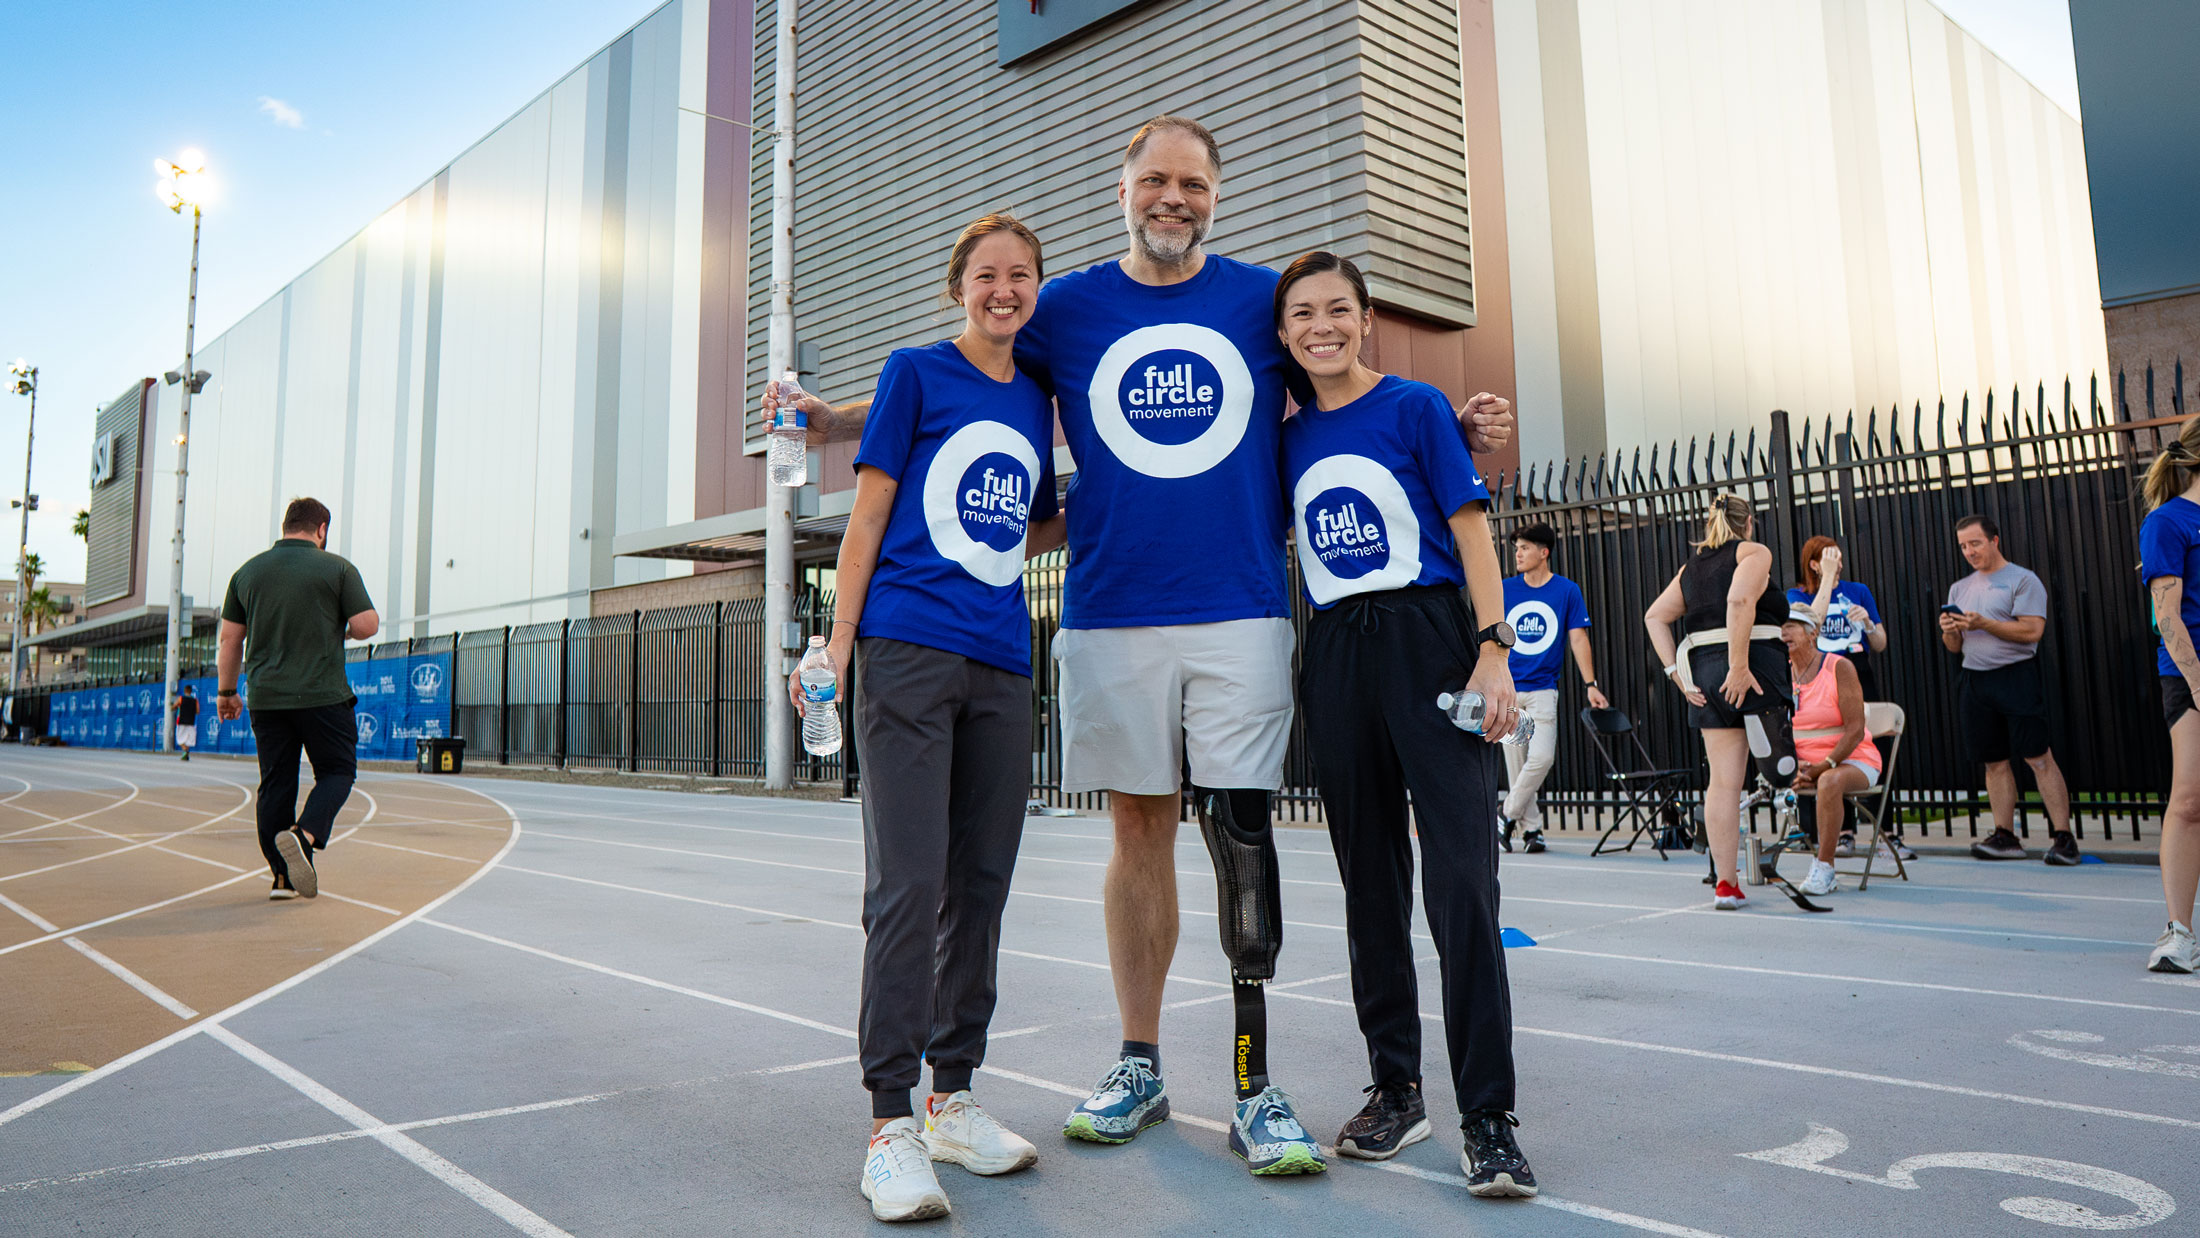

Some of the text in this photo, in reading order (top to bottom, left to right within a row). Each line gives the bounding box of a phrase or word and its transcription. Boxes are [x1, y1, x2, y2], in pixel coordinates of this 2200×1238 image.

[1144, 364, 1192, 388] full
[1128, 384, 1214, 406] circle
[1129, 404, 1214, 420] movement
[983, 467, 1022, 497] full
[965, 488, 1027, 521] circle
[1316, 502, 1355, 531] full
[962, 509, 1025, 536] movement
[1237, 1047, 1251, 1091] ÖSSUR
[1733, 1121, 2177, 1231] 5
